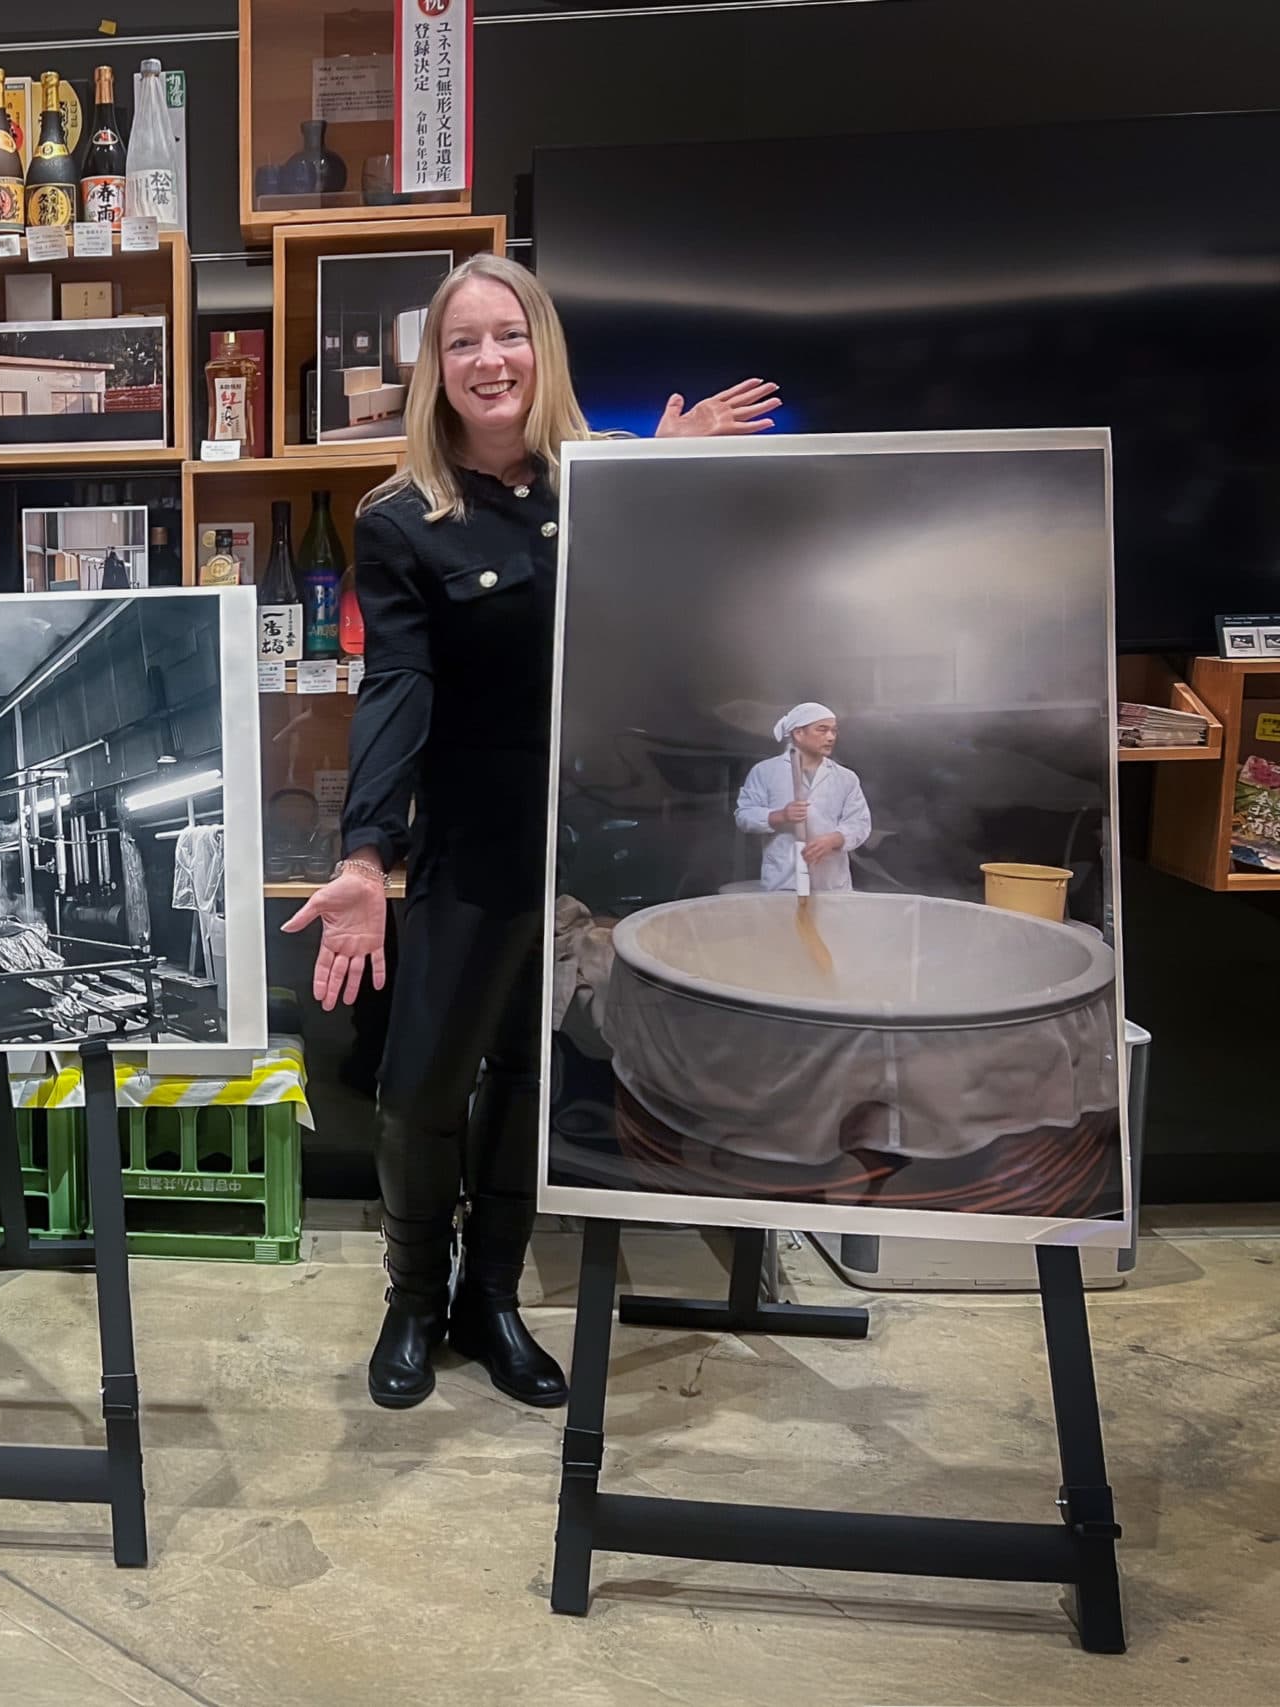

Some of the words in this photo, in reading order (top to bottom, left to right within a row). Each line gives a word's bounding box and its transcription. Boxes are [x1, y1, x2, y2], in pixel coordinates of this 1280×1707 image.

[413, 23, 430, 92] 登録決定
[435, 22, 453, 183] ユネスコ無形文化遺産
[415, 111, 429, 184] 令和6年12月
[97, 180, 116, 223] 春雨
[150, 170, 172, 205] 松藤
